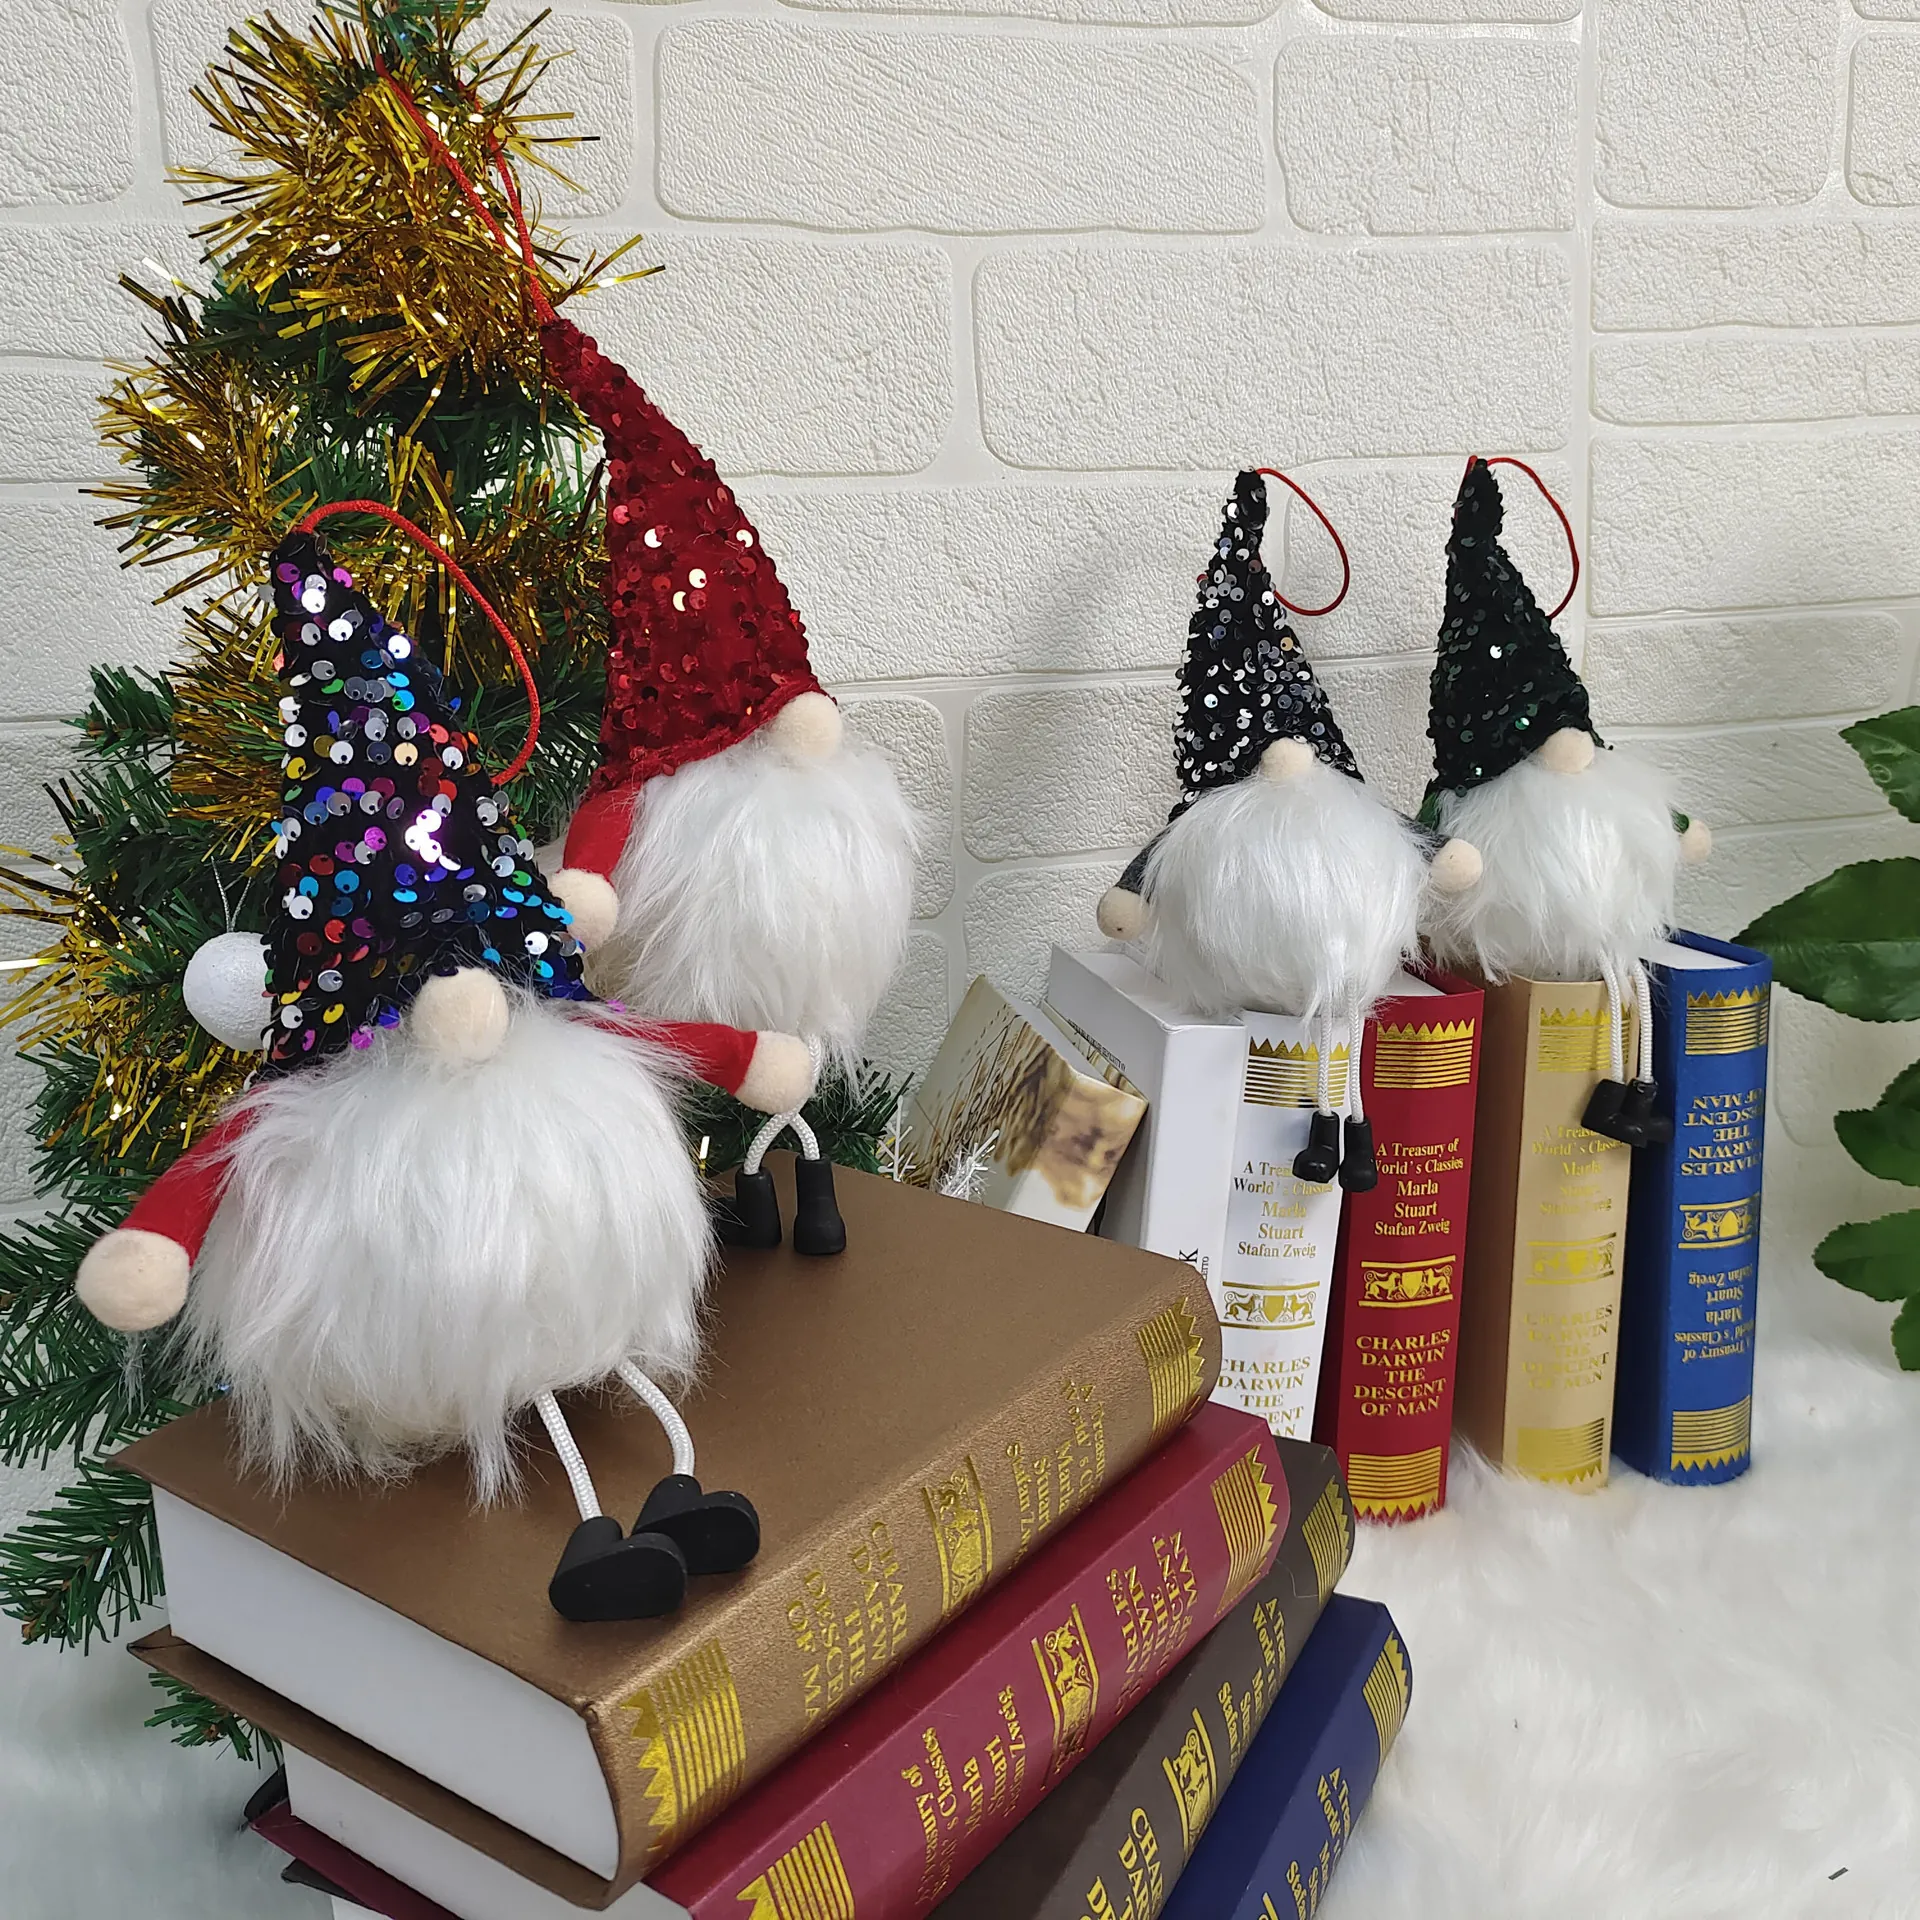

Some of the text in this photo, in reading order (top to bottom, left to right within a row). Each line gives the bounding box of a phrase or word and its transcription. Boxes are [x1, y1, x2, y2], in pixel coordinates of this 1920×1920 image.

[1692, 1092, 1742, 1110] MAN
[1557, 1125, 1600, 1139] Treas
[1712, 1124, 1750, 1142] THE
[1376, 1137, 1459, 1158] A Treasury of
[1243, 1160, 1293, 1177] A Trea
[1396, 1179, 1439, 1196] Marla
[1261, 1200, 1306, 1218] Marla
[1394, 1201, 1438, 1218] Stuart
[1258, 1223, 1304, 1239] Stuart
[1374, 1218, 1451, 1236] Stafan Zweig
[1237, 1241, 1316, 1258] Stafan Zweig
[1688, 1272, 1725, 1288] Zweig
[1706, 1284, 1744, 1305] Stuart
[1705, 1305, 1743, 1326] Marla
[1356, 1328, 1451, 1350] CHARLES
[1361, 1346, 1445, 1367] DARWIN
[1217, 1374, 1304, 1391] DARWIN
[1384, 1367, 1425, 1384] THE
[1353, 1378, 1446, 1400] DESCENT
[1240, 1394, 1283, 1407] THE
[1361, 1395, 1439, 1416] OF MAN
[1274, 1424, 1296, 1436] AN
[1169, 1530, 1198, 1610] MAN
[871, 1521, 909, 1656] CHARL
[853, 1544, 888, 1661] DARW
[1265, 1598, 1278, 1620] A
[1150, 1586, 1168, 1655] THE
[804, 1569, 844, 1709] DESCE
[802, 1664, 821, 1722] MA
[998, 1684, 1026, 1758] Zweig
[1218, 1681, 1239, 1751] Stafan
[901, 1763, 923, 1789] of
[984, 1734, 1008, 1816] Stuart
[1329, 1767, 1340, 1790] A
[962, 1756, 984, 1838] Marla
[1131, 1807, 1163, 1915] CHAR
[1118, 1833, 1150, 1920] DAR
[1286, 1860, 1307, 1920] Stafa
